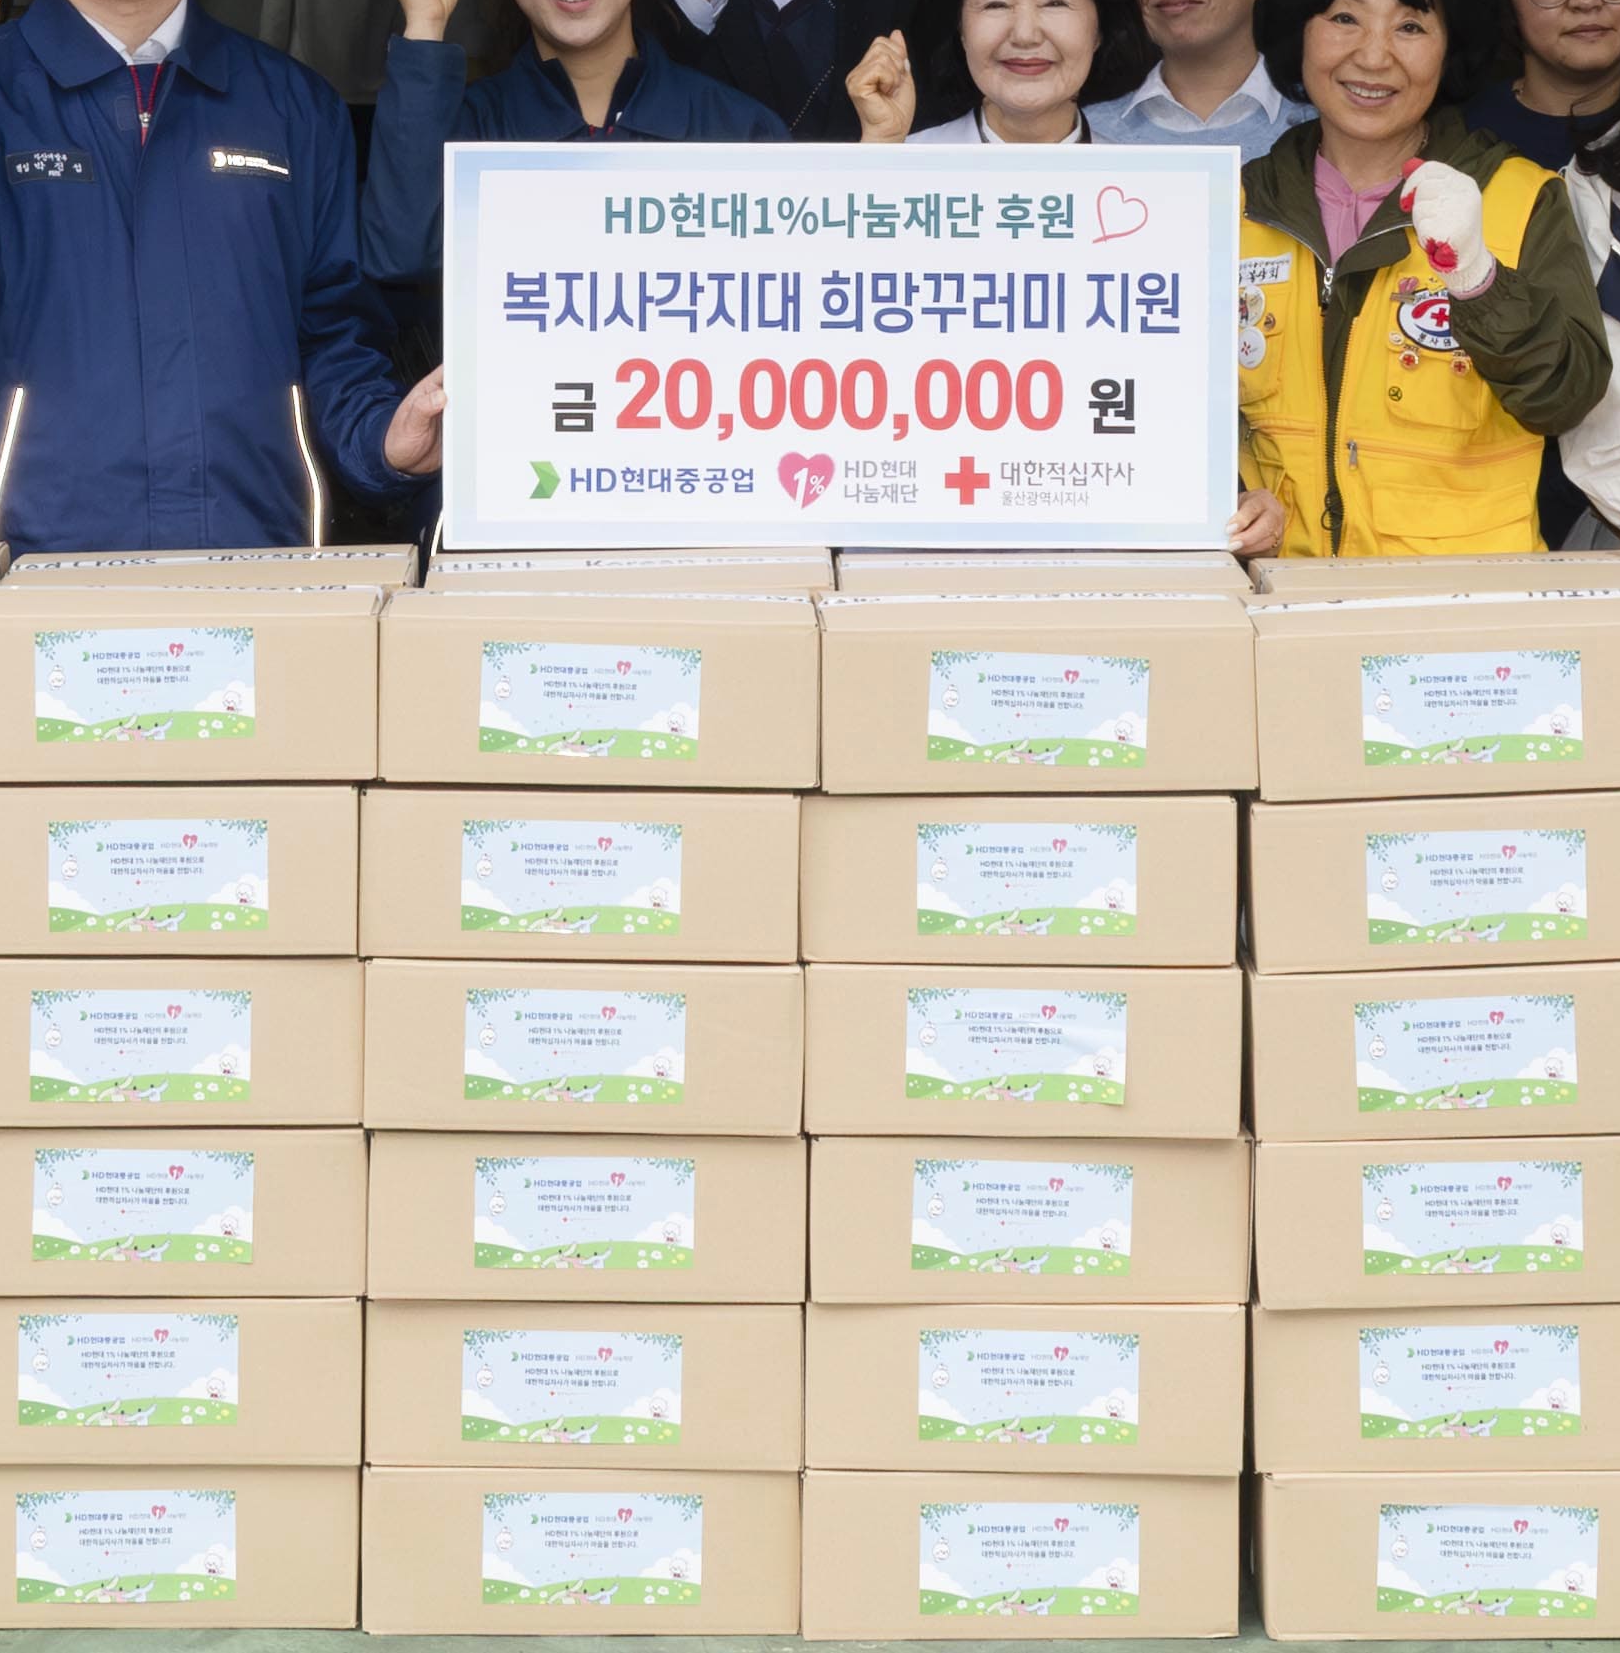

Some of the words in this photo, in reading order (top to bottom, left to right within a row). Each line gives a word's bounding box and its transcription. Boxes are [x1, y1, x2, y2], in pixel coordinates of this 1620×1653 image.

[604, 192, 985, 240] HD현대1%나눔재단
[995, 193, 1075, 240] 후원
[502, 271, 801, 333] 복지사각지대
[819, 269, 1066, 334] 희망꾸러미
[1085, 272, 1181, 335] 지원
[551, 382, 597, 433] 금
[615, 357, 1064, 442] 20,000,000
[1088, 378, 1136, 435] 원
[570, 466, 754, 495] HD현대중공업
[844, 459, 917, 479] HD현대
[1000, 459, 1136, 487] 대한적십자사
[843, 482, 920, 505] 나눔재단
[1000, 490, 1090, 508] 울산광역시지사
